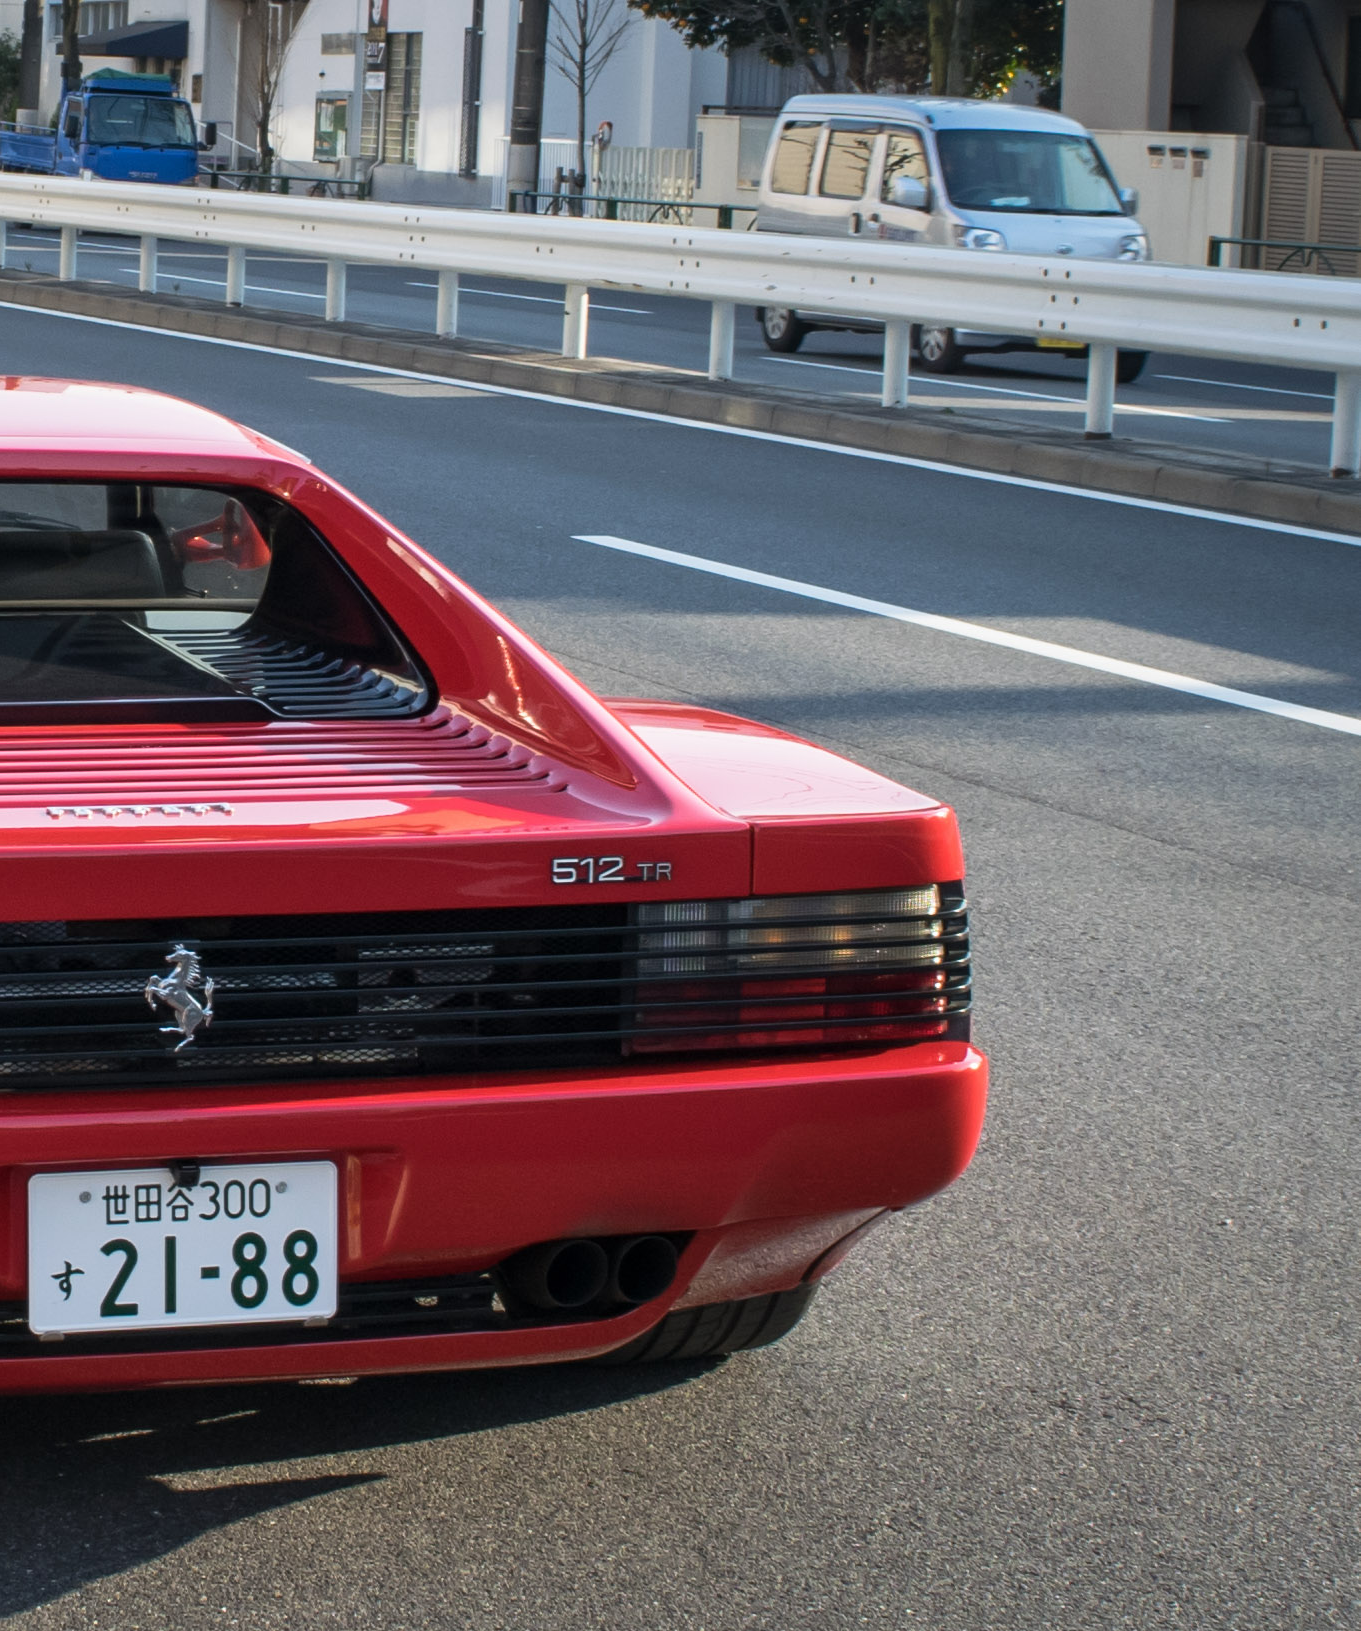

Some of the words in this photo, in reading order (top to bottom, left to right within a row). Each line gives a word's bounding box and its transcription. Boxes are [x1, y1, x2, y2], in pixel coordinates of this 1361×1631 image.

[552, 856, 625, 884] 512
[636, 862, 672, 882] TR
[51, 1260, 85, 1301] す
[99, 1229, 319, 1318] 21-88
